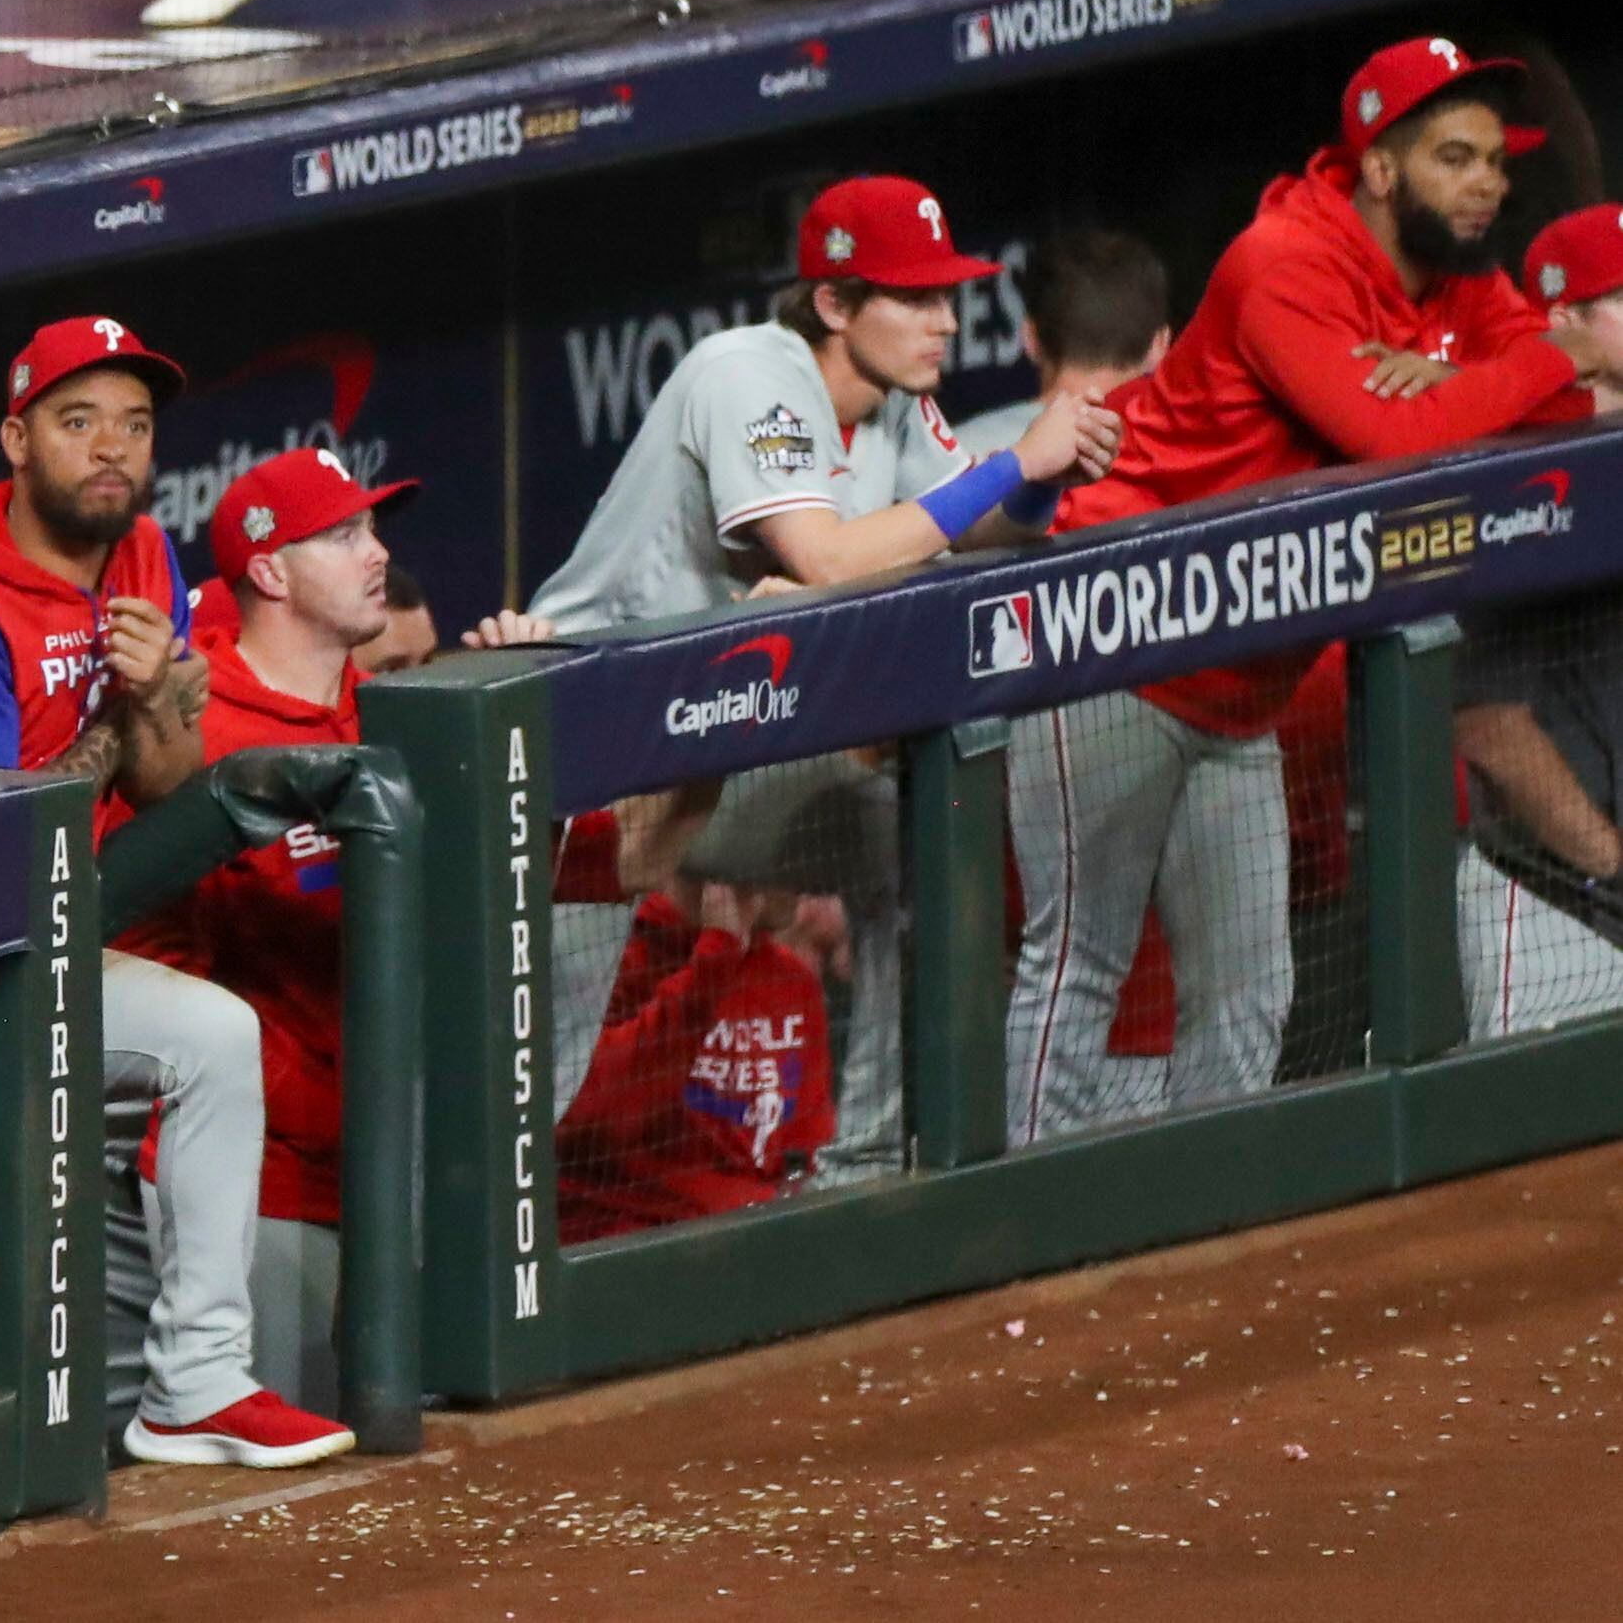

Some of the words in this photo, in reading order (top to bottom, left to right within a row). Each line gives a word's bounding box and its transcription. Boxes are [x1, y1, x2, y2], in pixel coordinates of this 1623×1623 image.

[329, 127, 434, 192] WORLD
[436, 104, 523, 171] SERIES
[755, 451, 815, 471] SERIES
[1036, 551, 1218, 669] WORLD
[1225, 511, 1376, 629] SERIES
[1380, 514, 1476, 571] 2022
